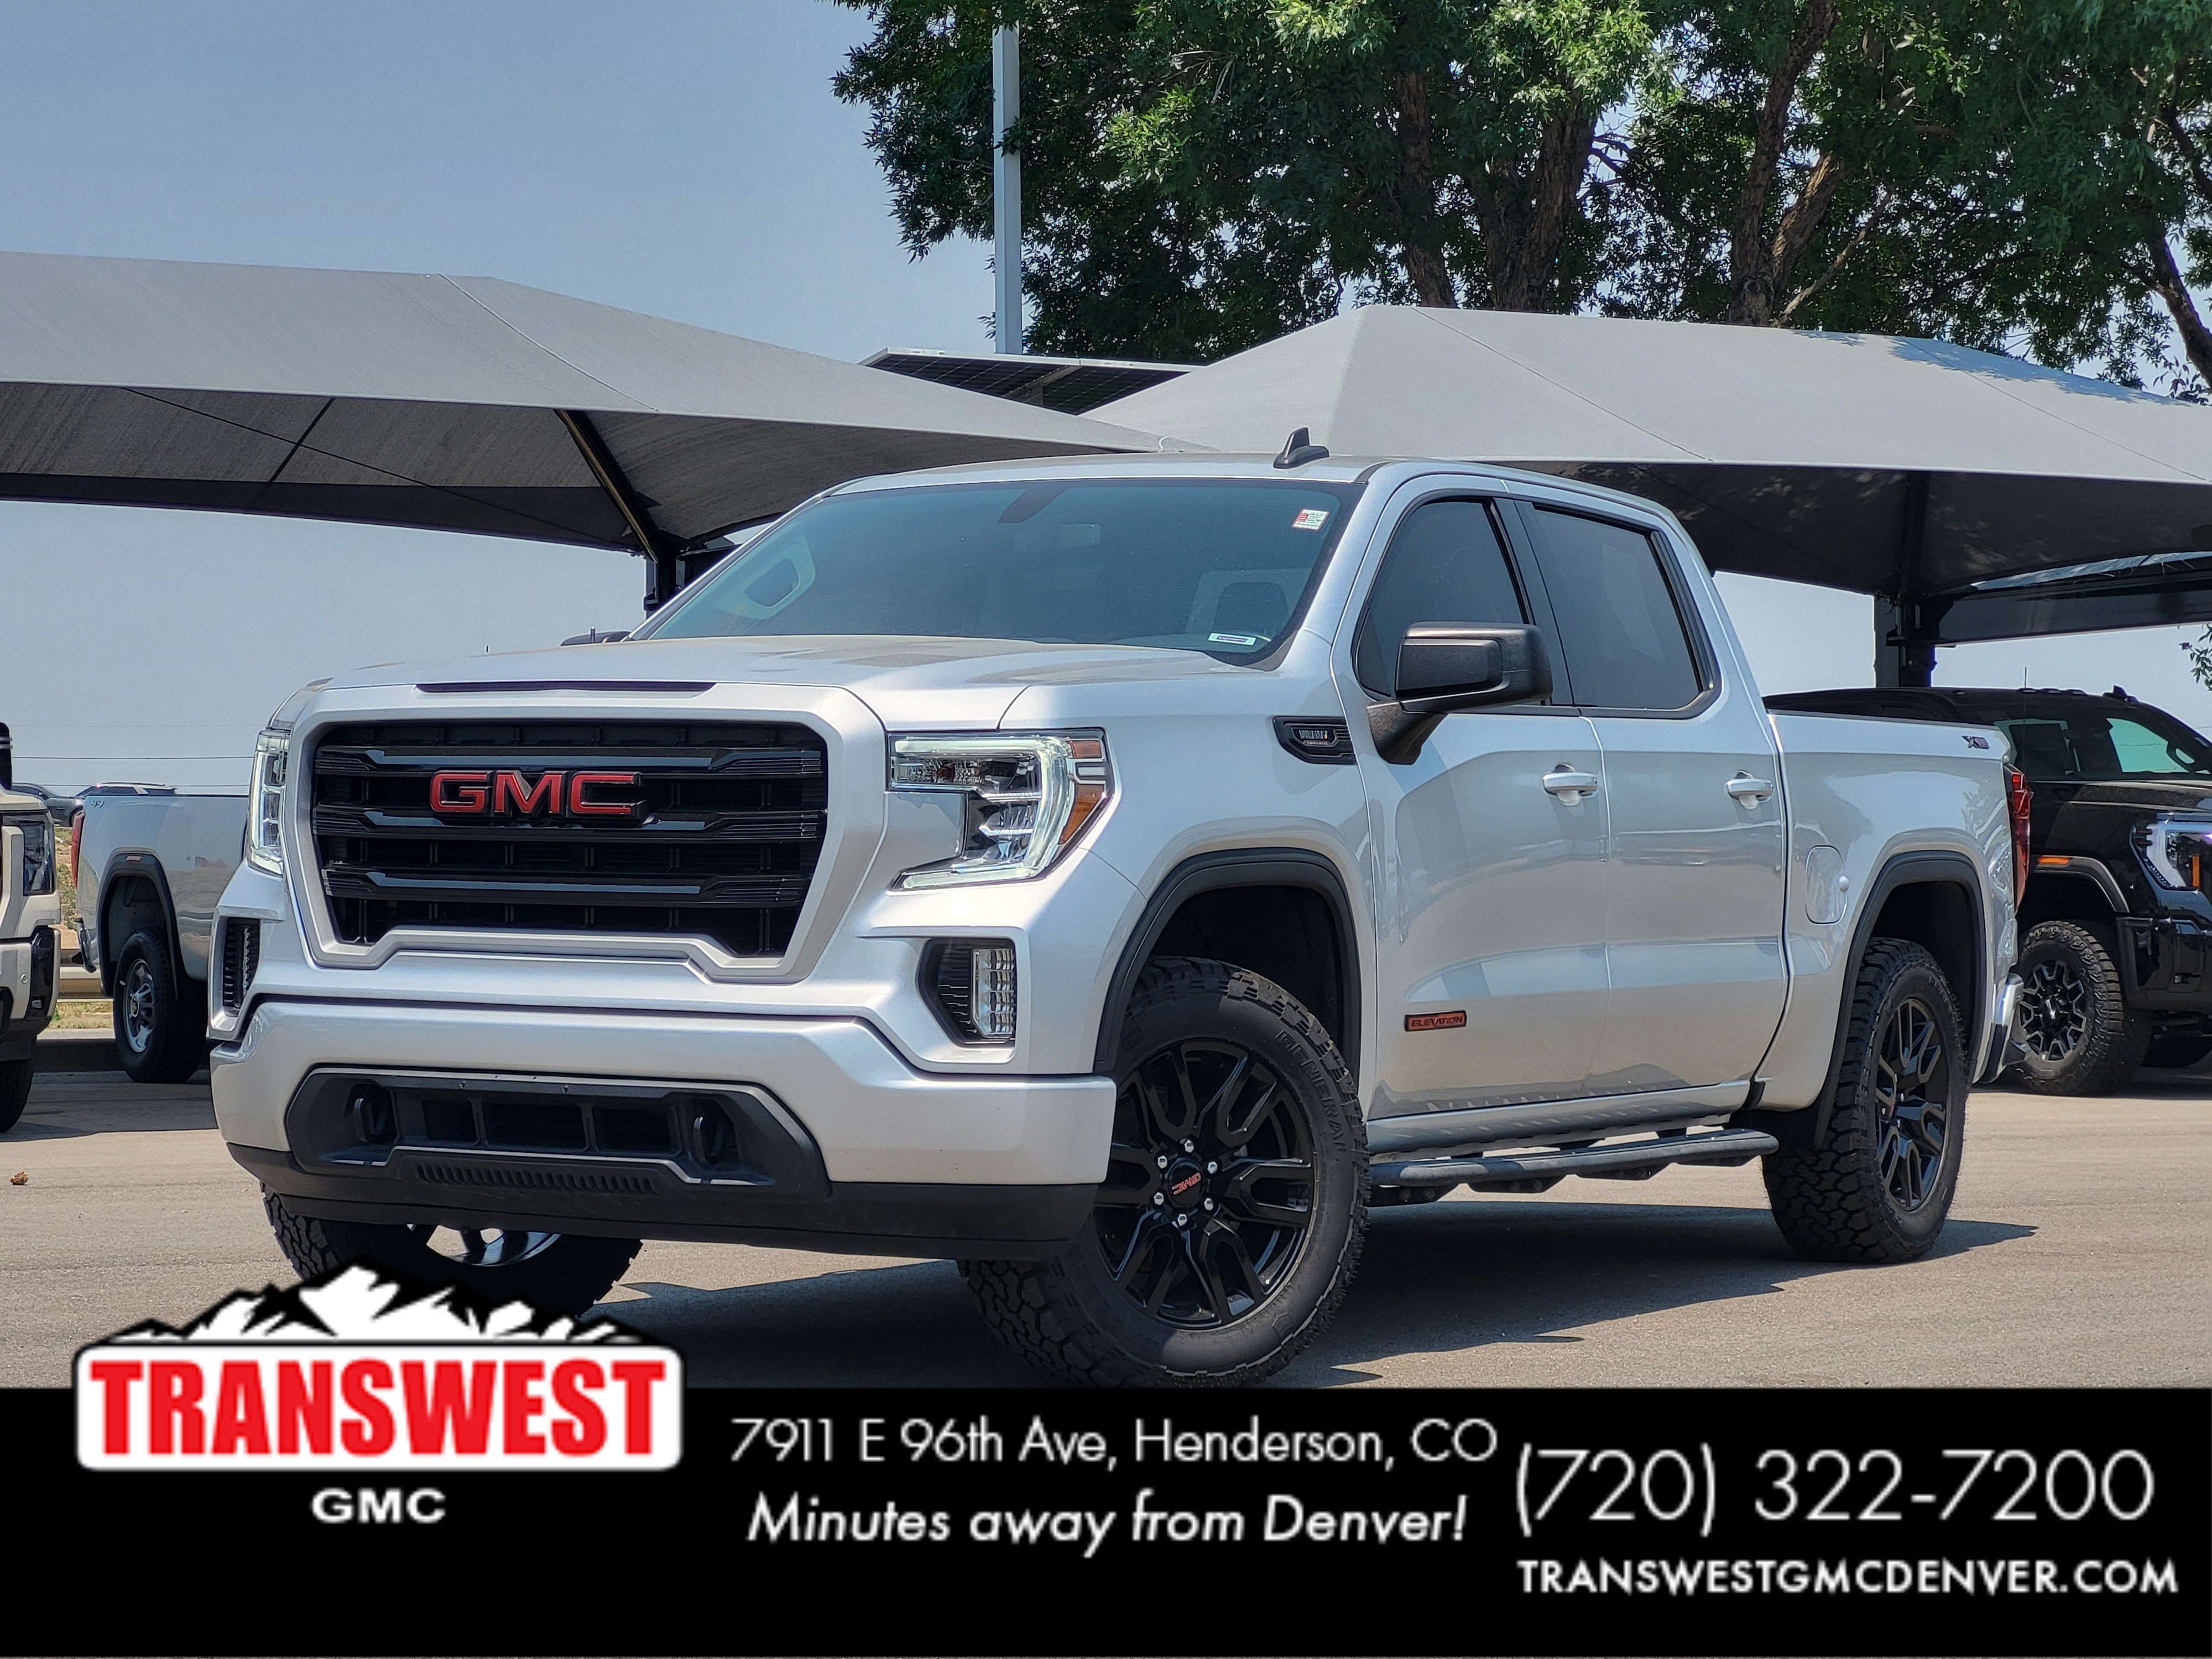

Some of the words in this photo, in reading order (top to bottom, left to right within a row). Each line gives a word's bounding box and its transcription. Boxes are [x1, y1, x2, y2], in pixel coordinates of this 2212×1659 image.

[430, 770, 643, 816] GMC
[1411, 1016, 1463, 1027] ELEVATION
[1275, 1030, 1348, 1152] GENERAL
[1172, 1172, 1201, 1195] GMC
